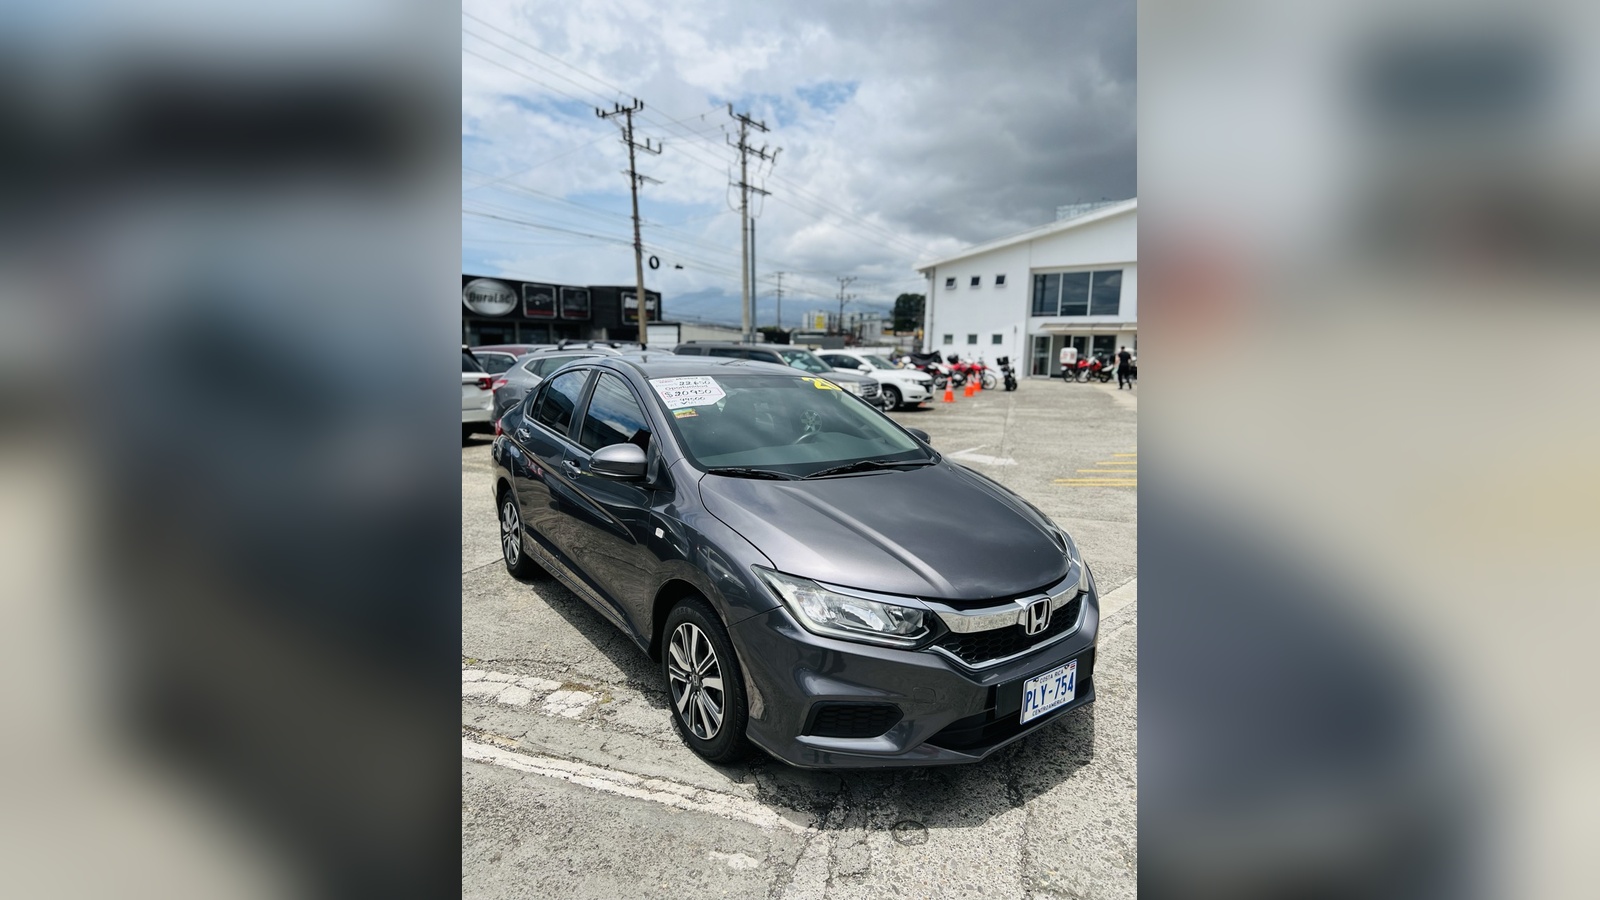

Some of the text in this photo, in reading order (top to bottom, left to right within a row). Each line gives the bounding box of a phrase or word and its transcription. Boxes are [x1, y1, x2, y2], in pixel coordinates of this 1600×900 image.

[1039, 669, 1064, 683] COSTA RICA
[1025, 671, 1074, 712] PLY-754
[1032, 697, 1066, 716] CENTROAMERICA
